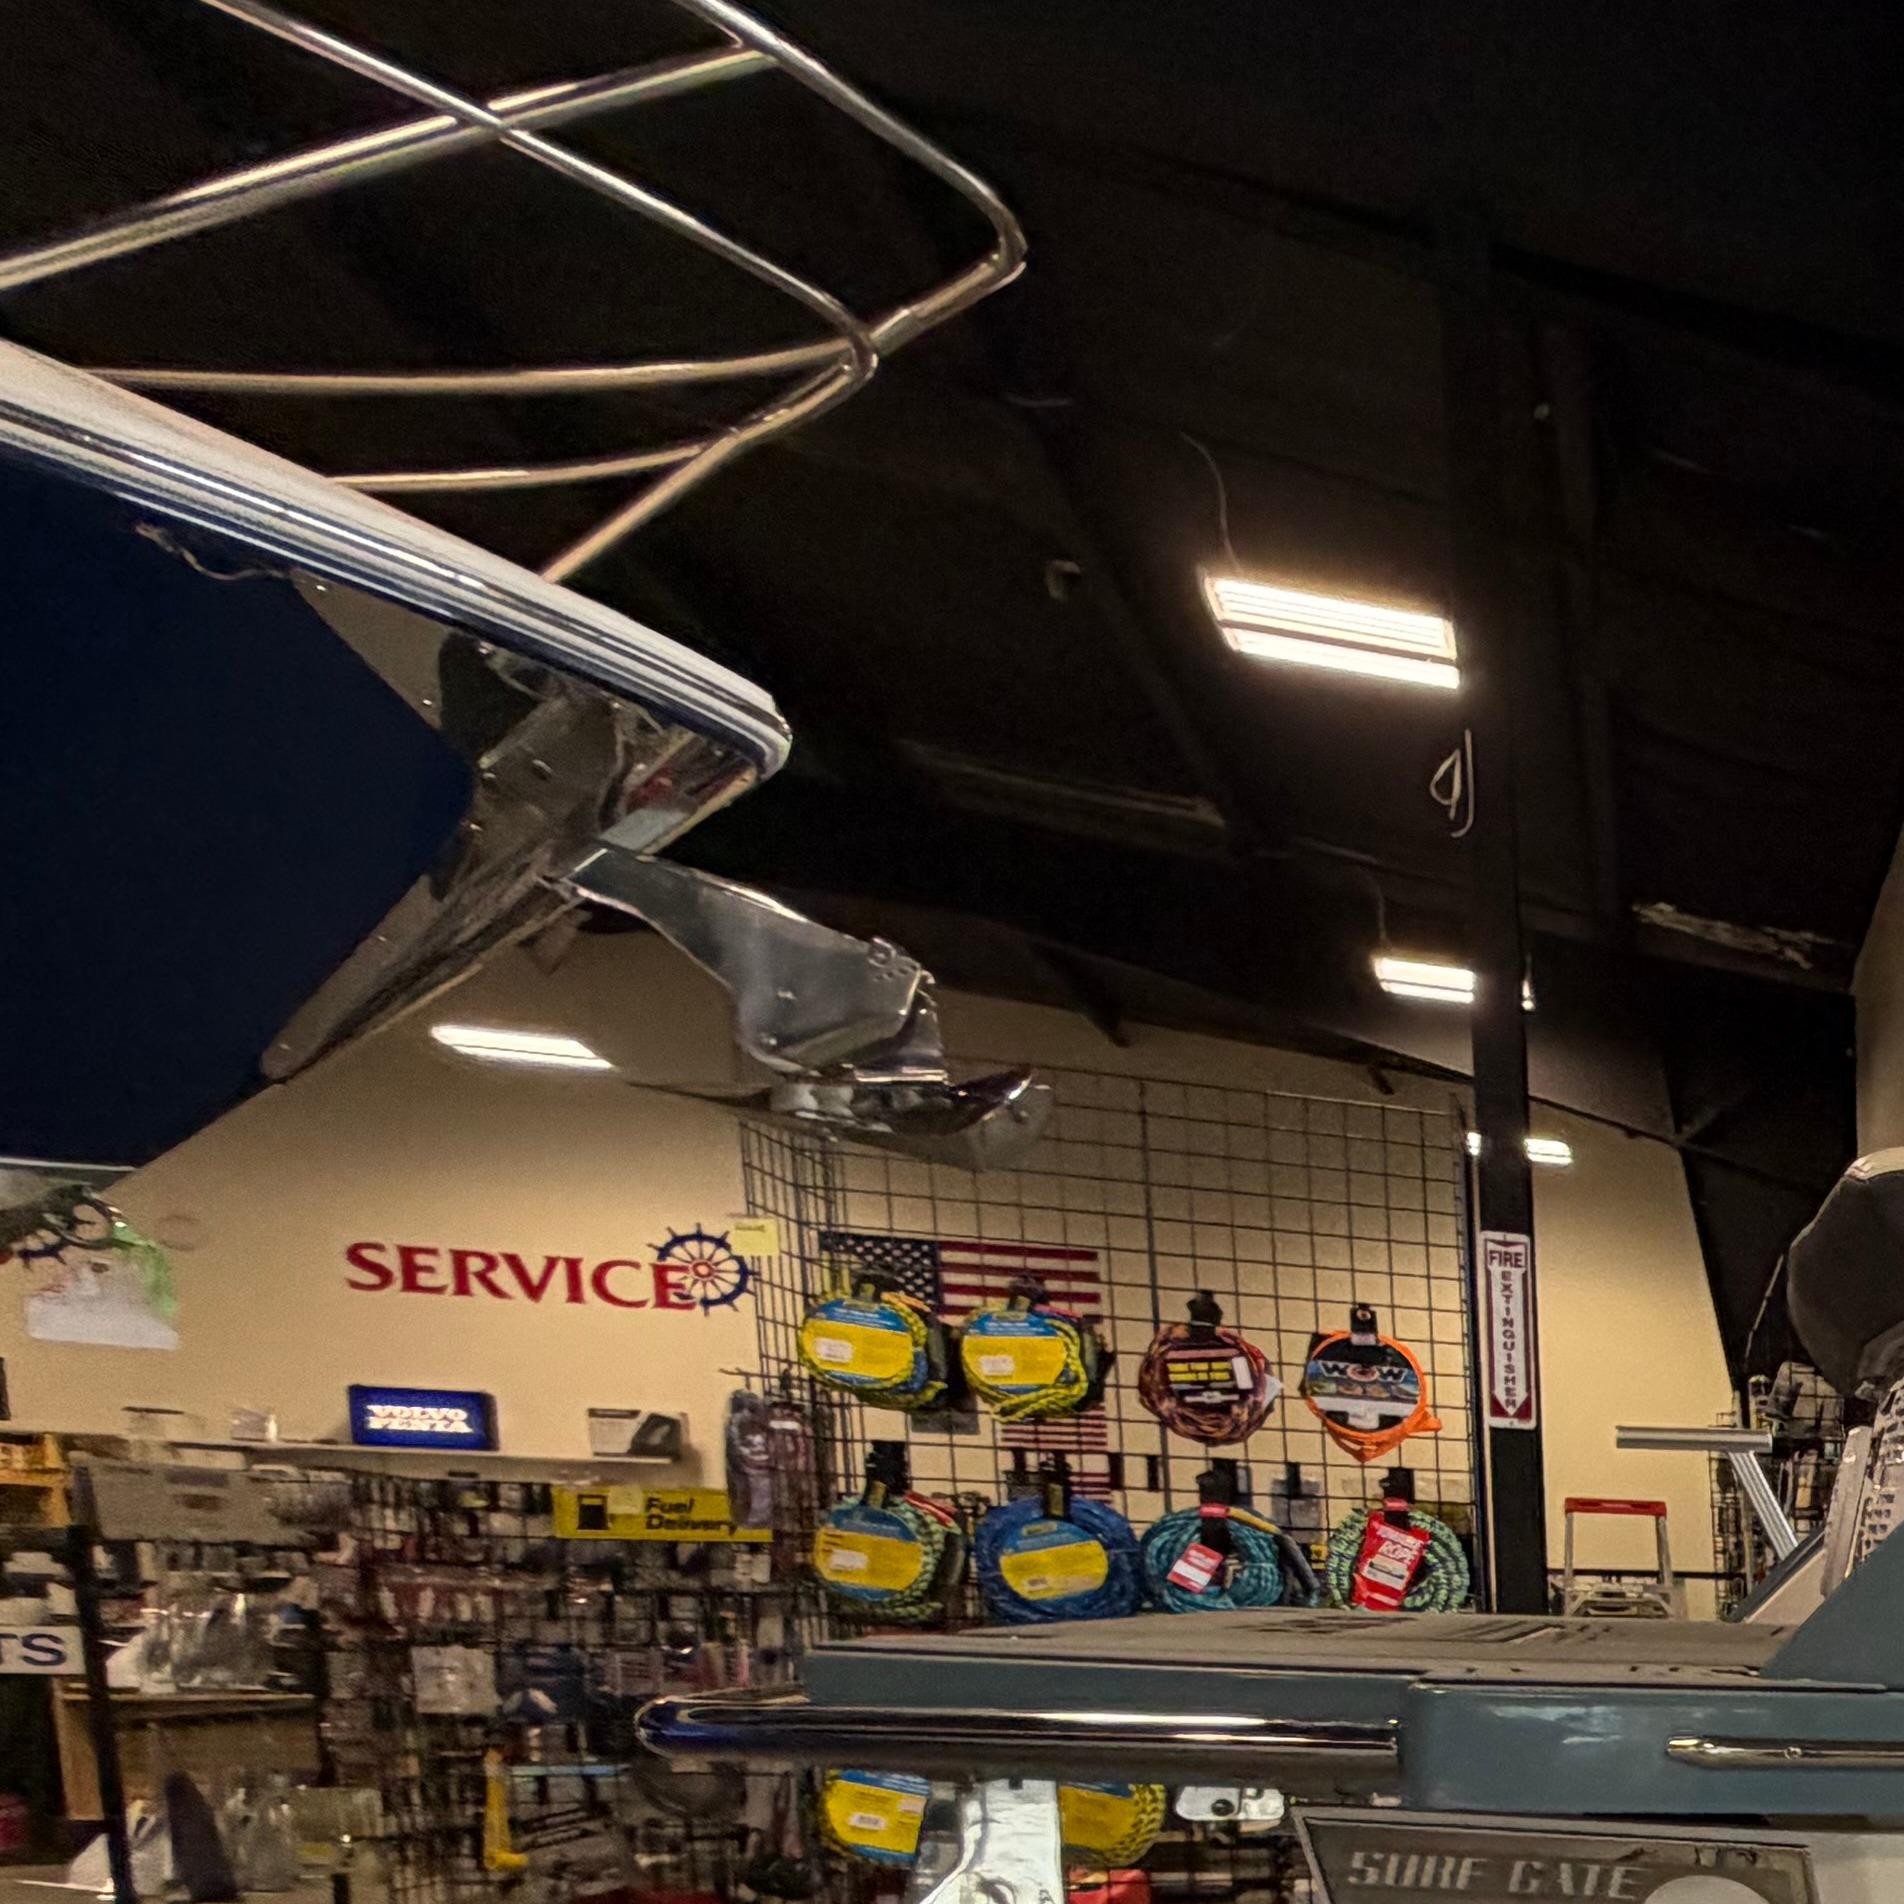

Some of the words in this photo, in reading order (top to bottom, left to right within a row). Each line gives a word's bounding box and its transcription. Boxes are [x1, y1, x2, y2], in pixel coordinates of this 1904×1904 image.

[1488, 1249, 1524, 1268] FIRE
[345, 1242, 697, 1311] SERVICE
[1500, 1271, 1517, 1409] EXTINGUISHER
[1319, 1360, 1408, 1384] WOW
[366, 1404, 468, 1421] VOLVO
[645, 1496, 695, 1513] Fuel
[645, 1513, 737, 1536] Delivery
[1347, 1850, 1490, 1890] SURF
[1507, 1859, 1661, 1901] GATE
